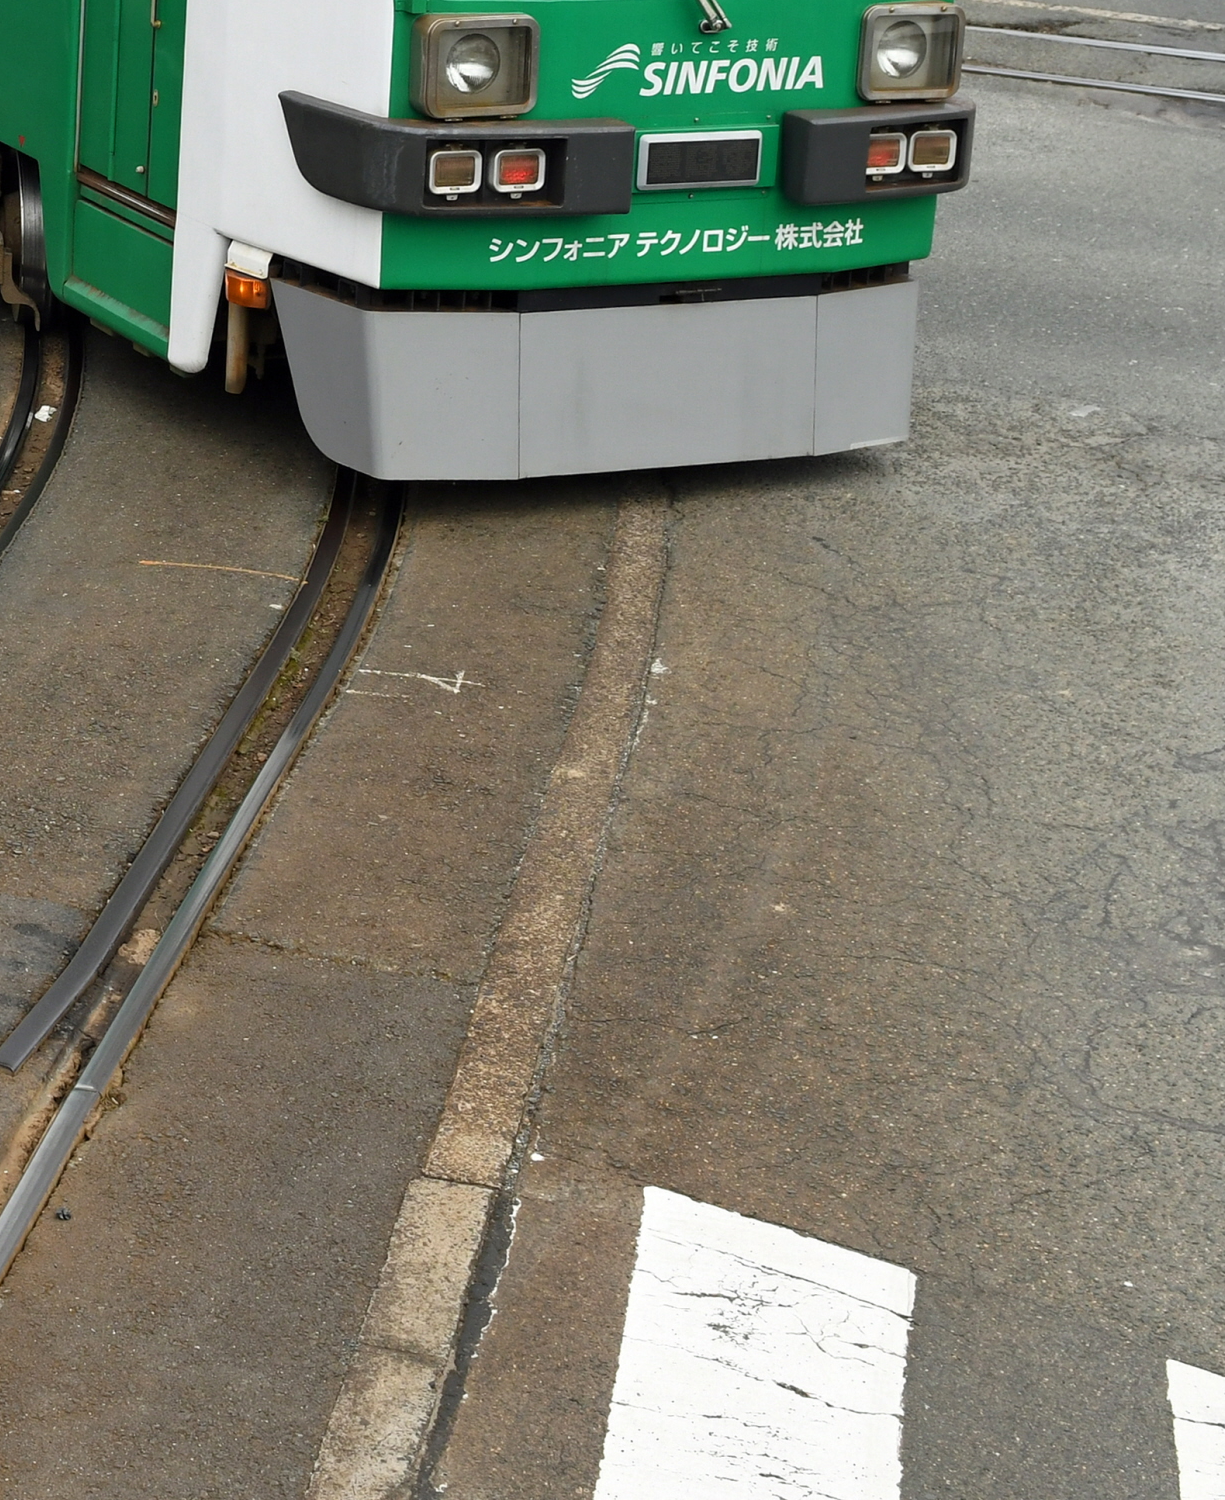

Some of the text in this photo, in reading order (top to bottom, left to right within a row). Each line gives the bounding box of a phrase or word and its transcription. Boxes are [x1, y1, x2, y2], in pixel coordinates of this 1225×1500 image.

[650, 38, 779, 56] 響いてこそ技術
[639, 55, 824, 97] SINFONIA
